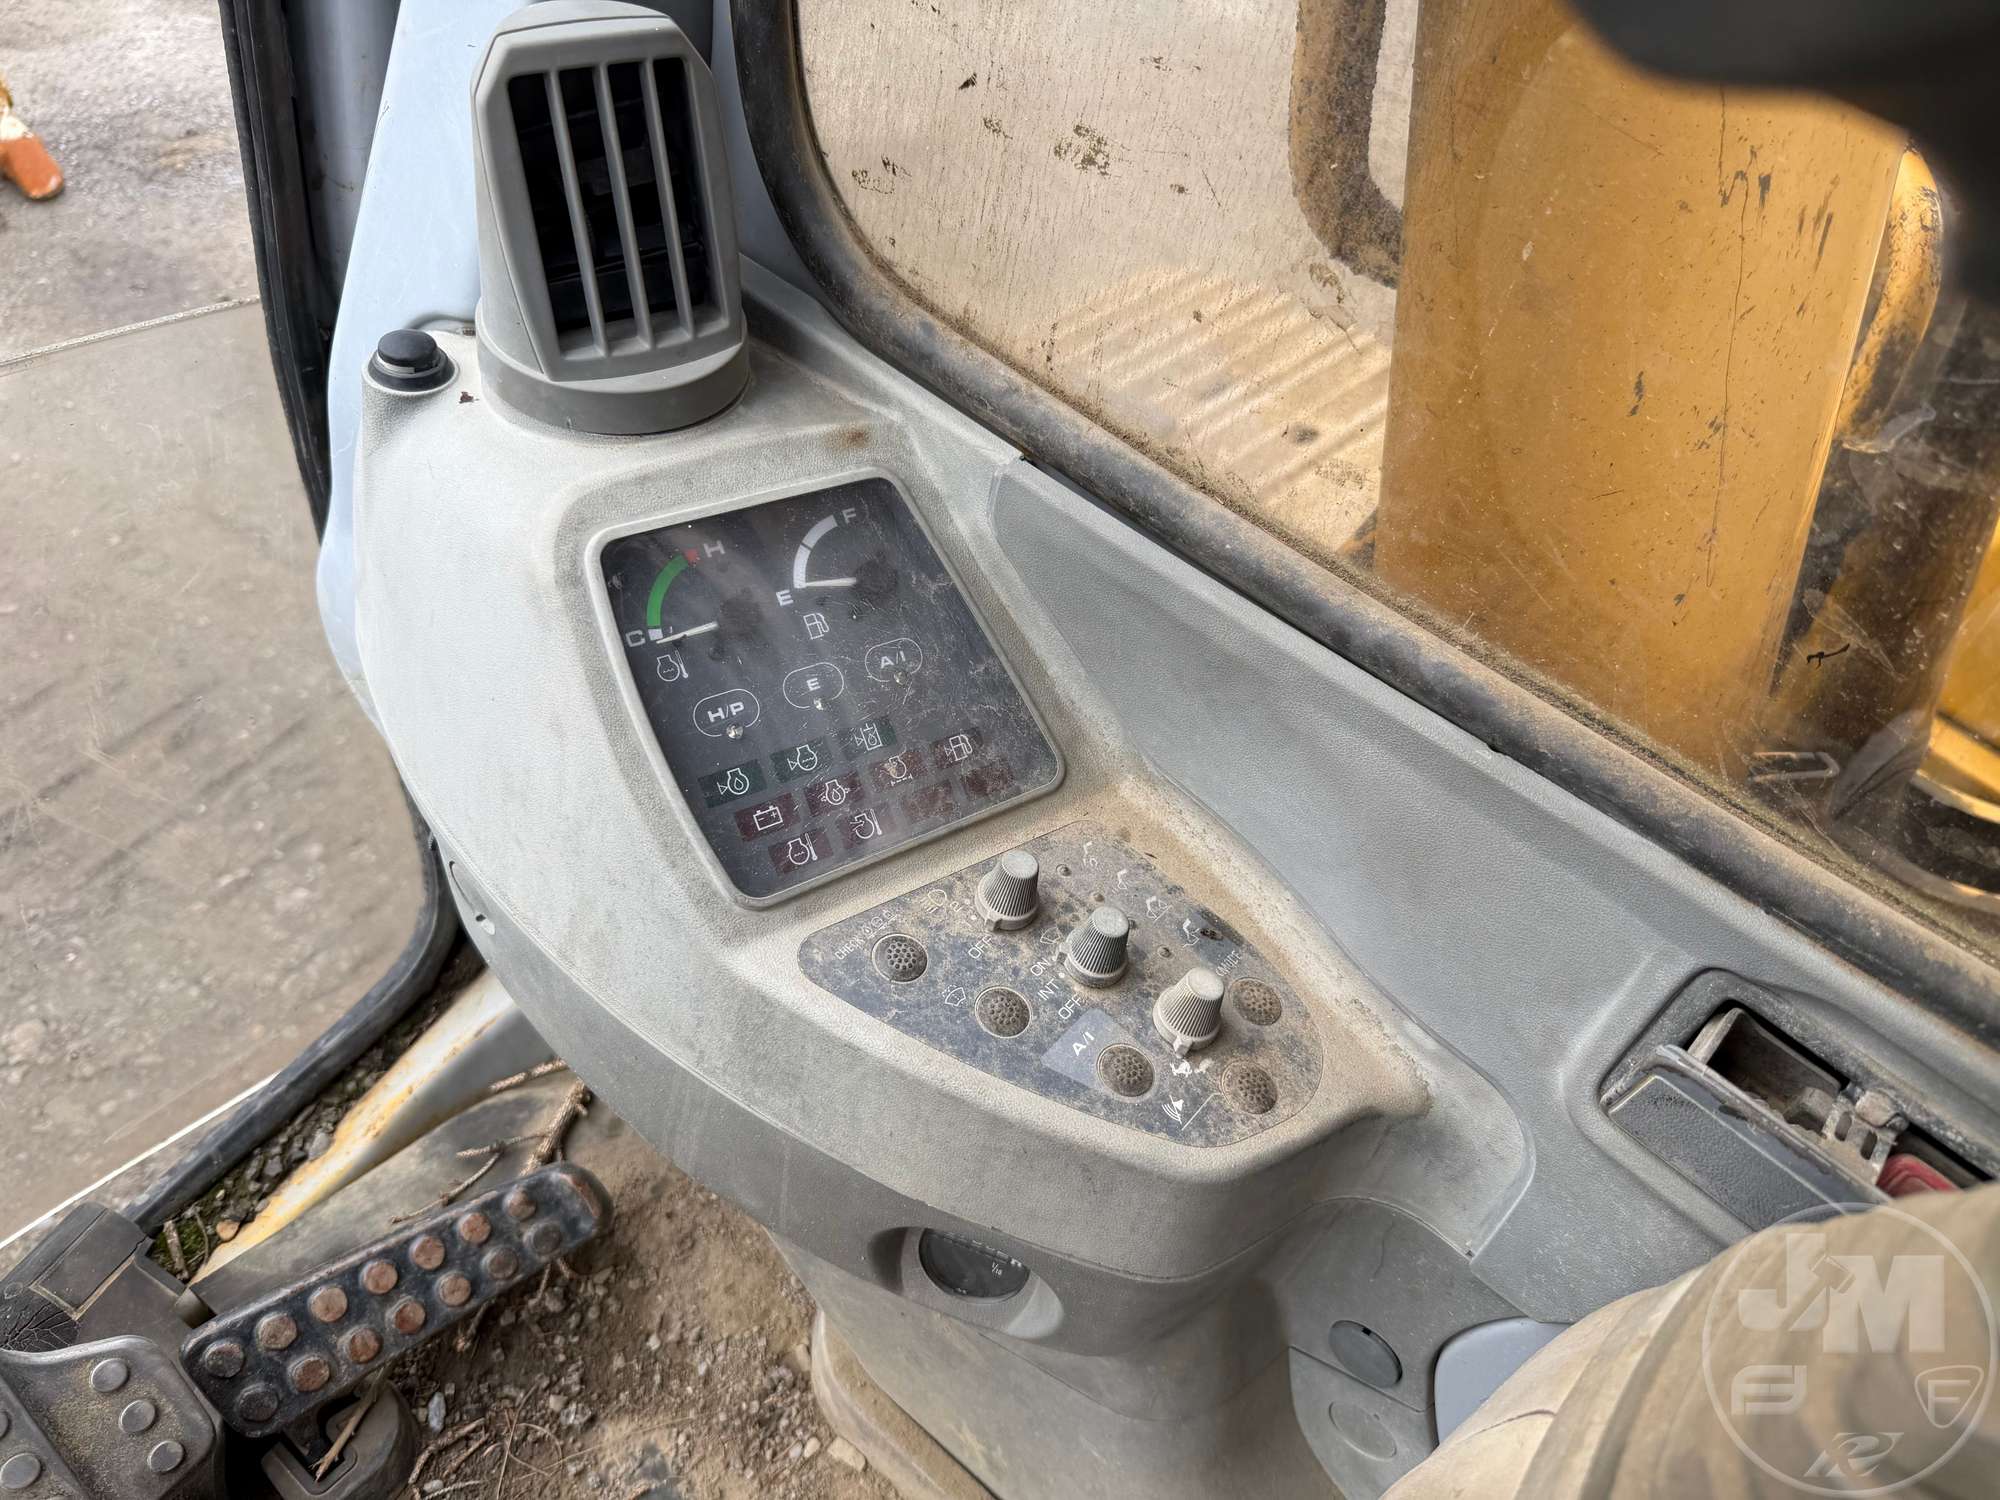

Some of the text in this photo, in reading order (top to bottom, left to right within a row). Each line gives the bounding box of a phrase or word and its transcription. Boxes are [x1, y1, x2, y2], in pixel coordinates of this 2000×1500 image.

[842, 508, 857, 523] F
[703, 540, 726, 558] H
[776, 589, 794, 606] E
[625, 629, 646, 647] C
[880, 650, 906, 669] A/I
[806, 677, 821, 692] E
[707, 701, 745, 723] H/P
[968, 935, 993, 959] OFF
[1030, 957, 1052, 976] ON
[1037, 978, 1060, 1001] INT
[1058, 992, 1082, 1020] OFF
[1072, 1031, 1095, 1057] A/I
